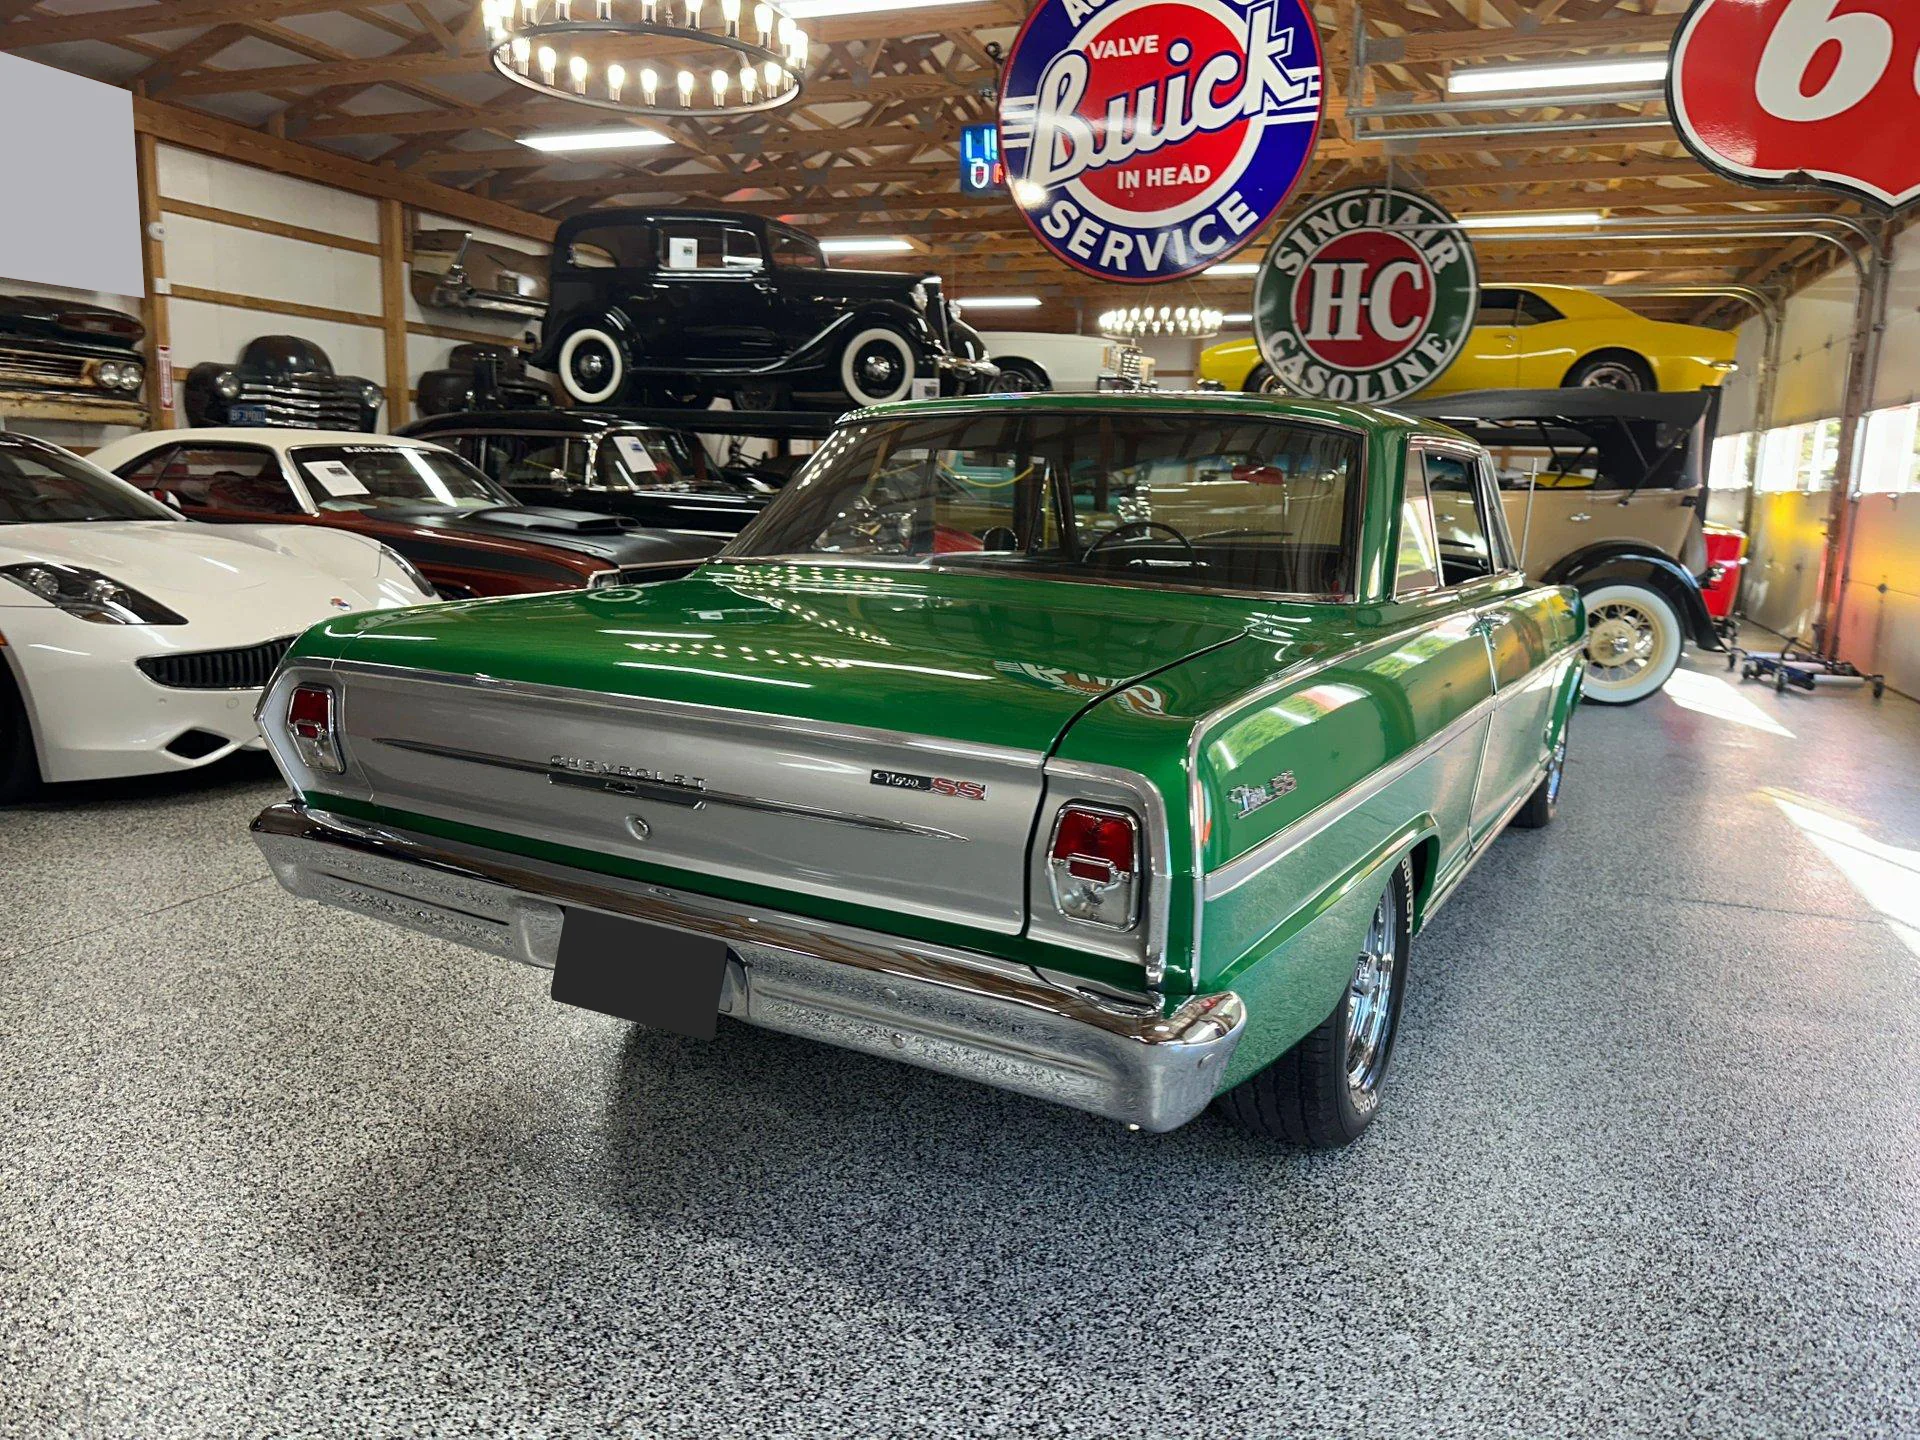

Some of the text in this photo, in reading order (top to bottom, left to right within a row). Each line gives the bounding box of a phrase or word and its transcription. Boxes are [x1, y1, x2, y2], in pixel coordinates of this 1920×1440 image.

[1089, 34, 1159, 60] VALVE
[1755, 0, 1920, 122] 6
[1026, 2, 1306, 190] Buick
[1117, 163, 1211, 190] IN HEAD
[1041, 190, 1259, 272] SERVICE
[1274, 198, 1461, 277] SINCLAIR
[1266, 331, 1452, 401] GASOLINE
[550, 754, 708, 793] CHEVROLET
[873, 771, 985, 801] Nova SS
